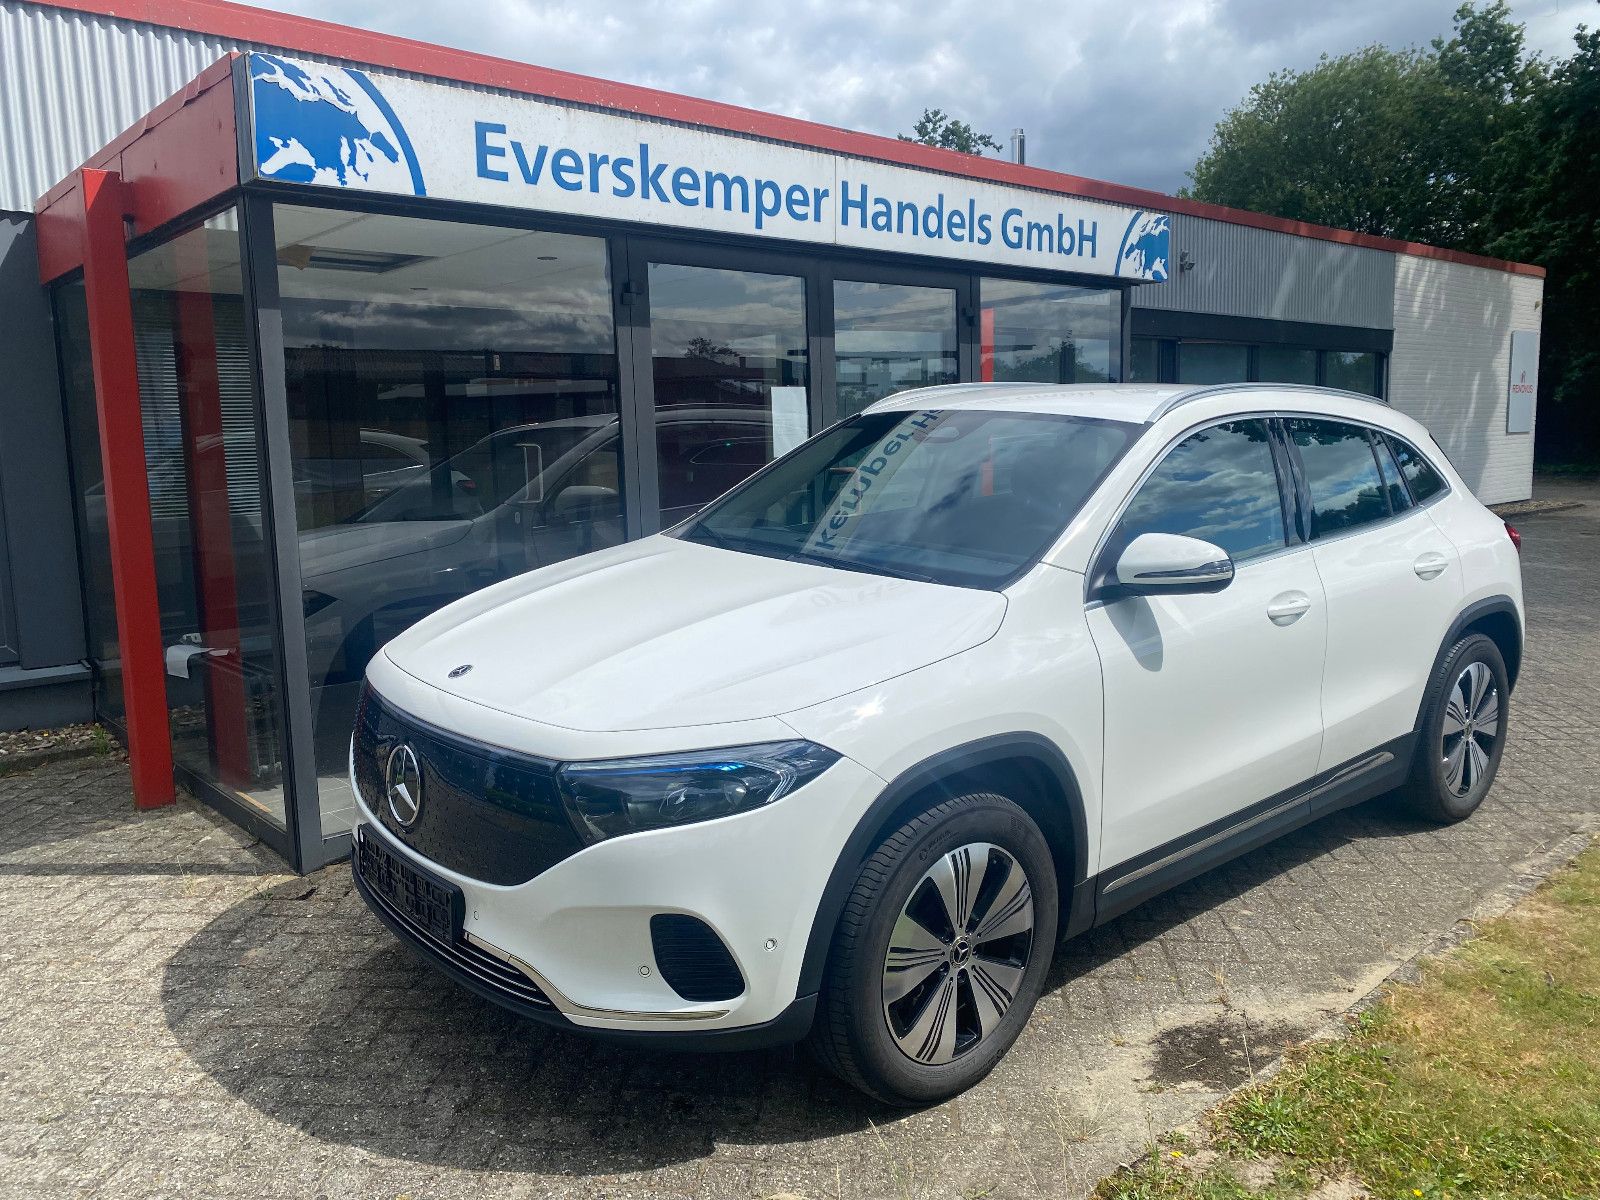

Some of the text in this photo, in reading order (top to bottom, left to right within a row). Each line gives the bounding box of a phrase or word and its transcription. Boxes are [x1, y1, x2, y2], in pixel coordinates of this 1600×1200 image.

[475, 121, 1098, 258] Everskemper Handels GmbH
